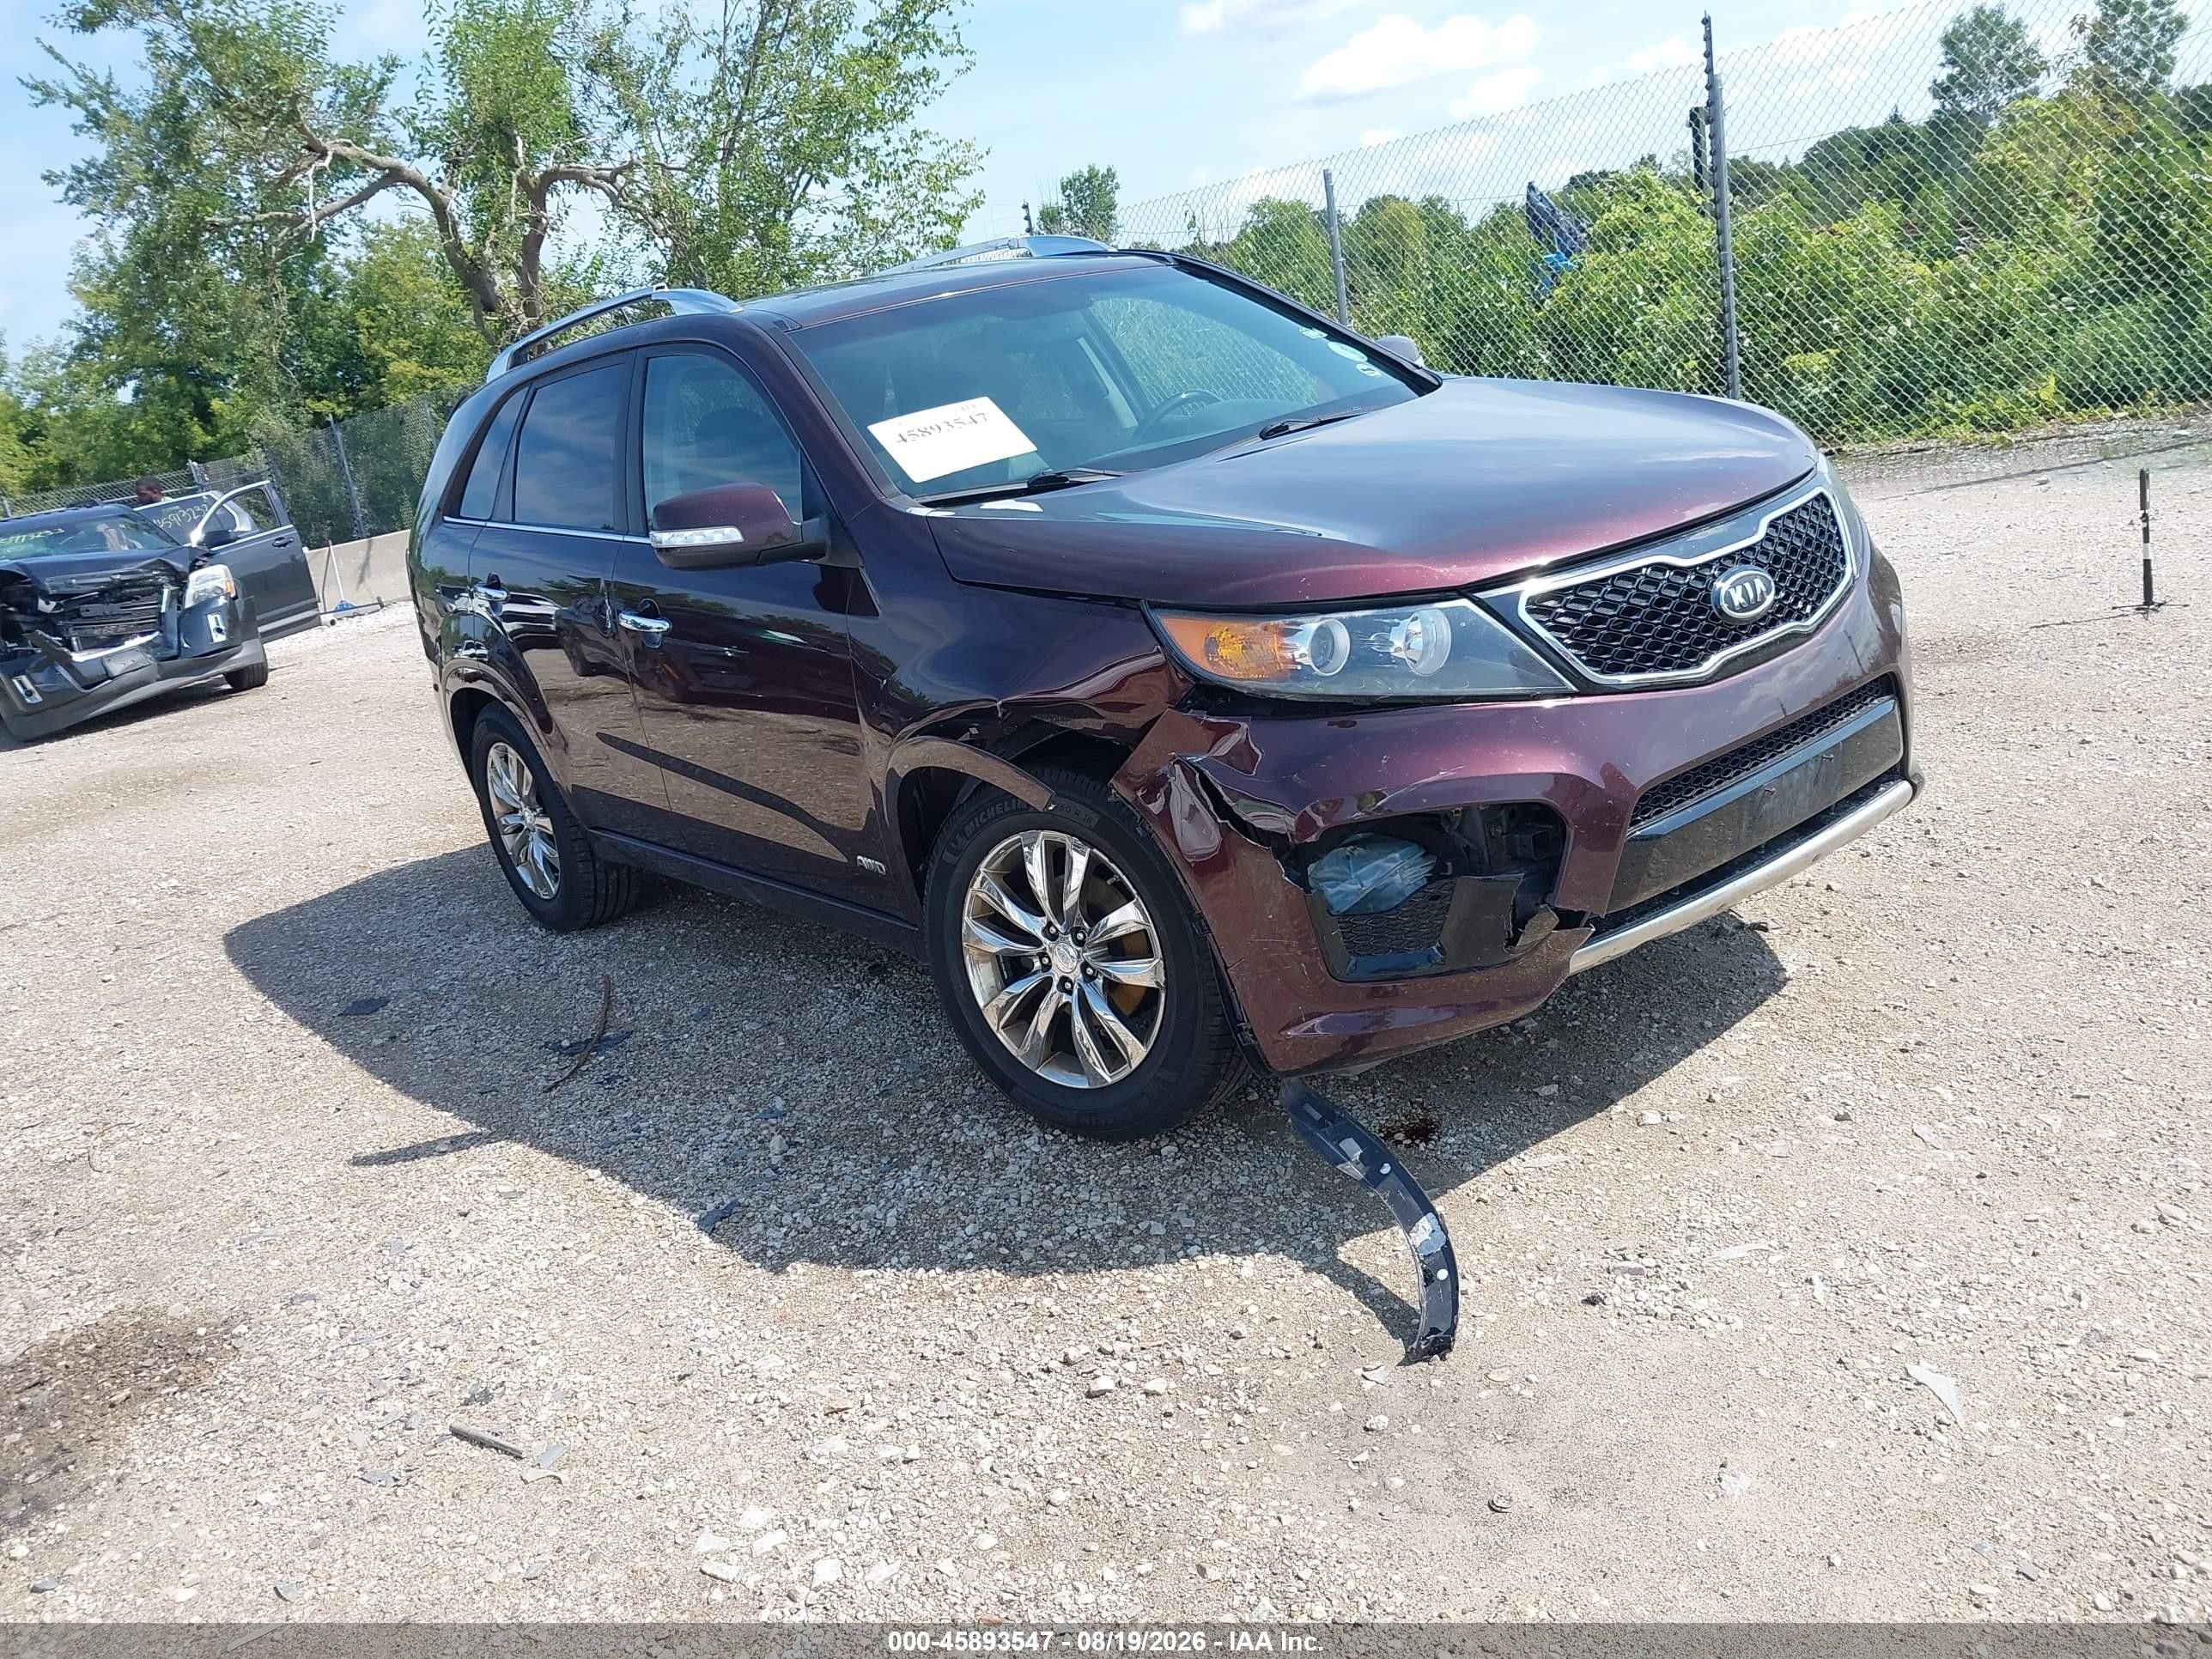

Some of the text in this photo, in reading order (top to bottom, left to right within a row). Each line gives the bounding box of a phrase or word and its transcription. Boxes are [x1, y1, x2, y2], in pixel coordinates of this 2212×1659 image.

[896, 412, 988, 443] 45893547
[1729, 577, 1767, 611] KIA
[857, 855, 886, 875] AWD
